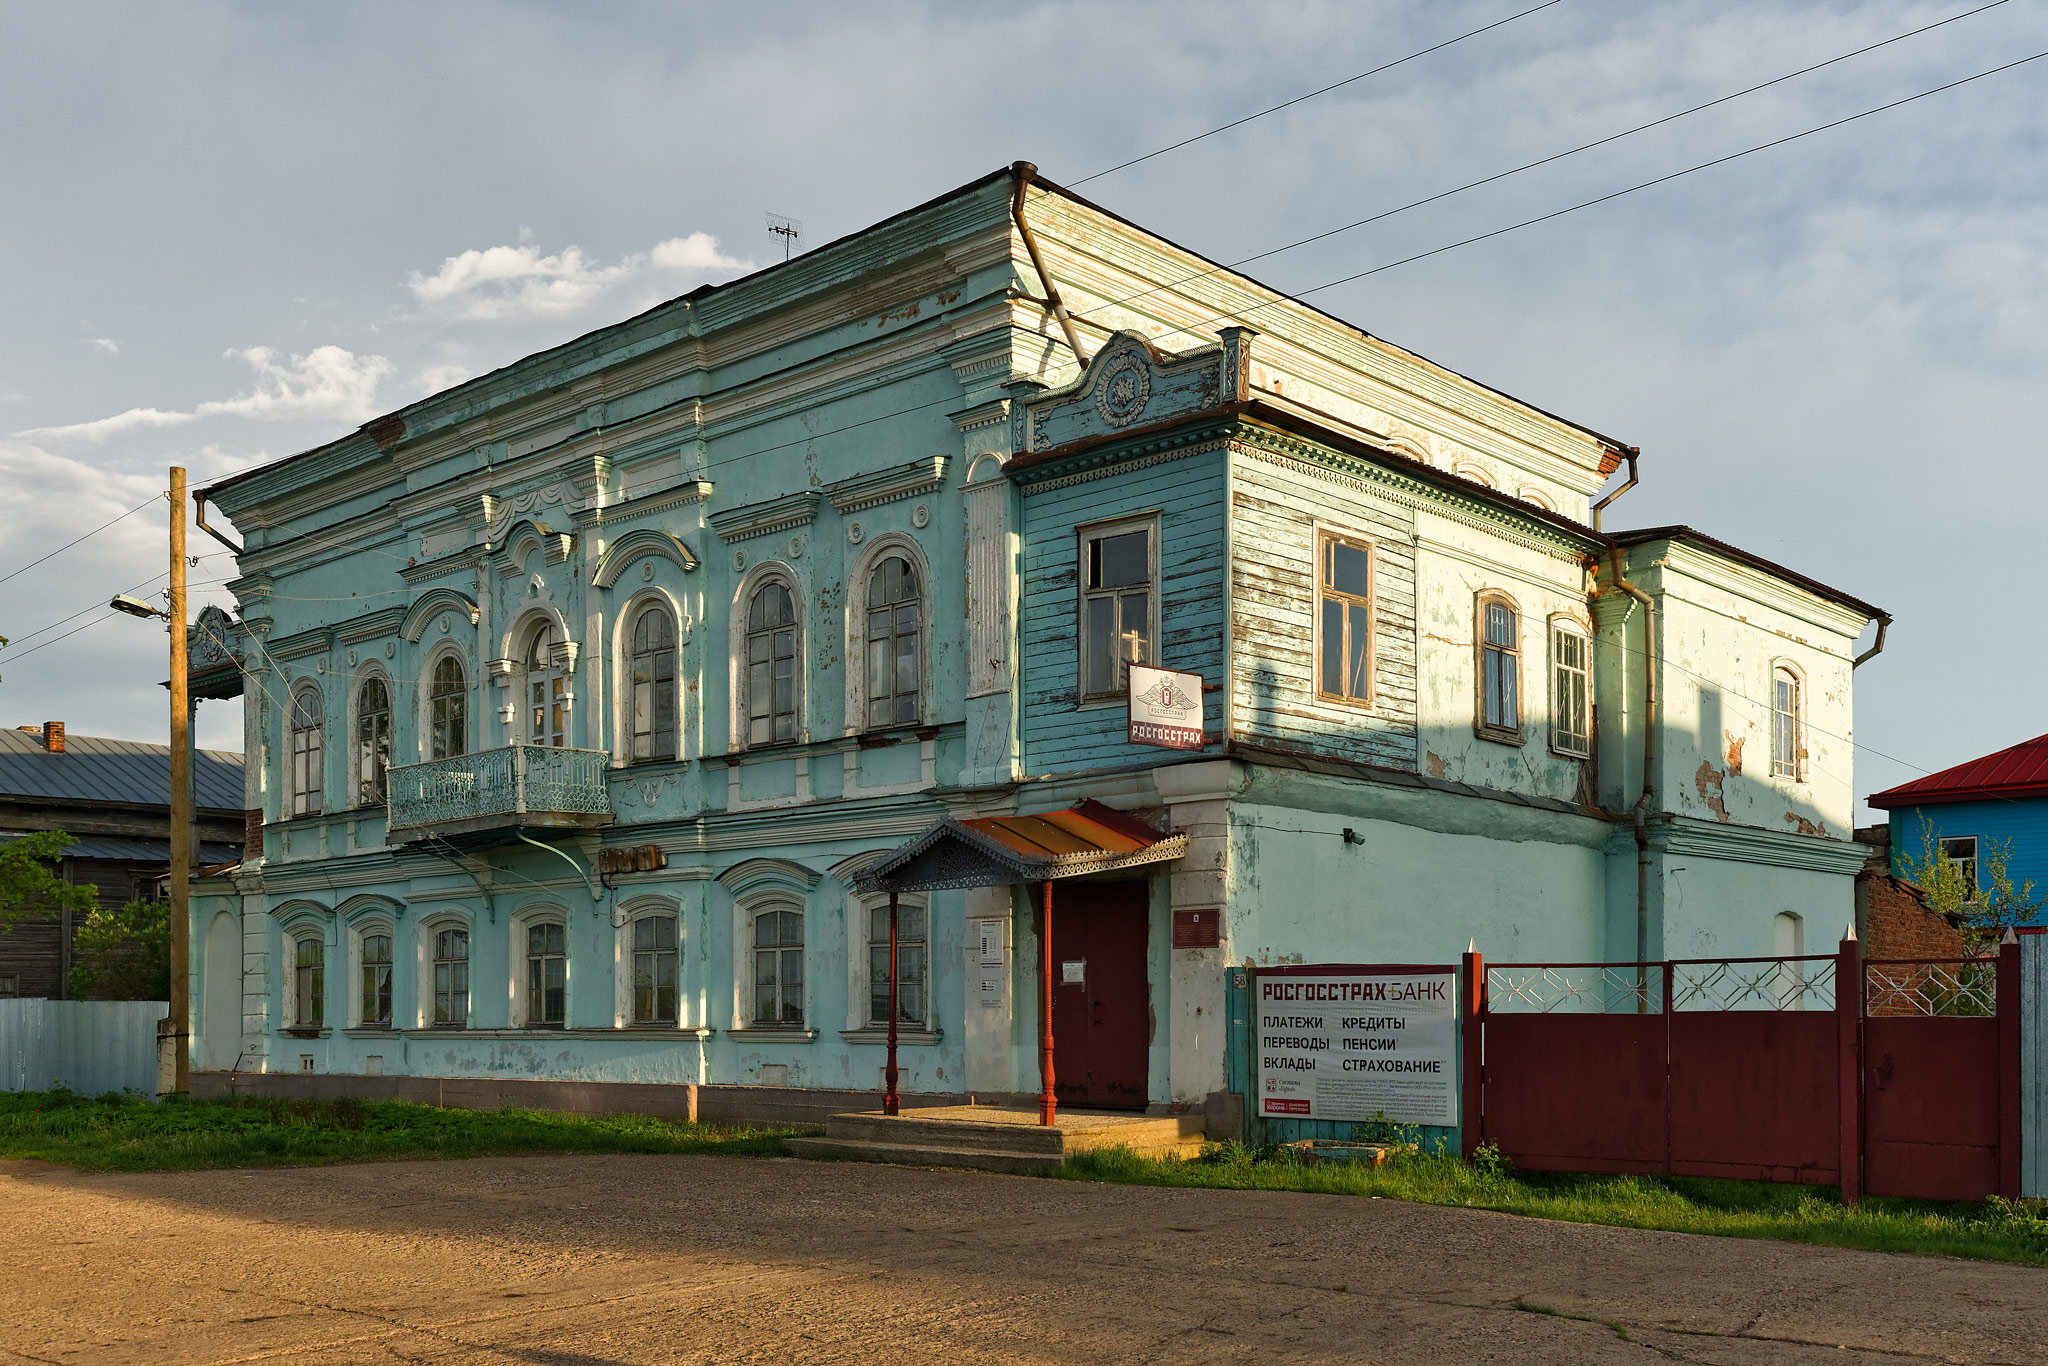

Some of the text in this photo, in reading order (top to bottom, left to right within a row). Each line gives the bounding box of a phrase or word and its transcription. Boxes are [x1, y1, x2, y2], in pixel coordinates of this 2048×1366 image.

[1132, 726, 1201, 744] РОСГОССТРАХ
[1234, 975, 1246, 986] 58
[1263, 981, 1446, 1001] РОСГОССТРАХ БАНК
[1263, 1016, 1323, 1029] ПЛАТЕЖИ
[1342, 1017, 1406, 1032] КРЕДИТЫ
[1263, 1036, 1330, 1052] ПЕРЕВОДЫ
[1342, 1038, 1397, 1051] ПЕНСИИ
[1263, 1057, 1316, 1072] ВКЛАДЫ
[1342, 1059, 1441, 1073] СТРАХОВАНИЕ
